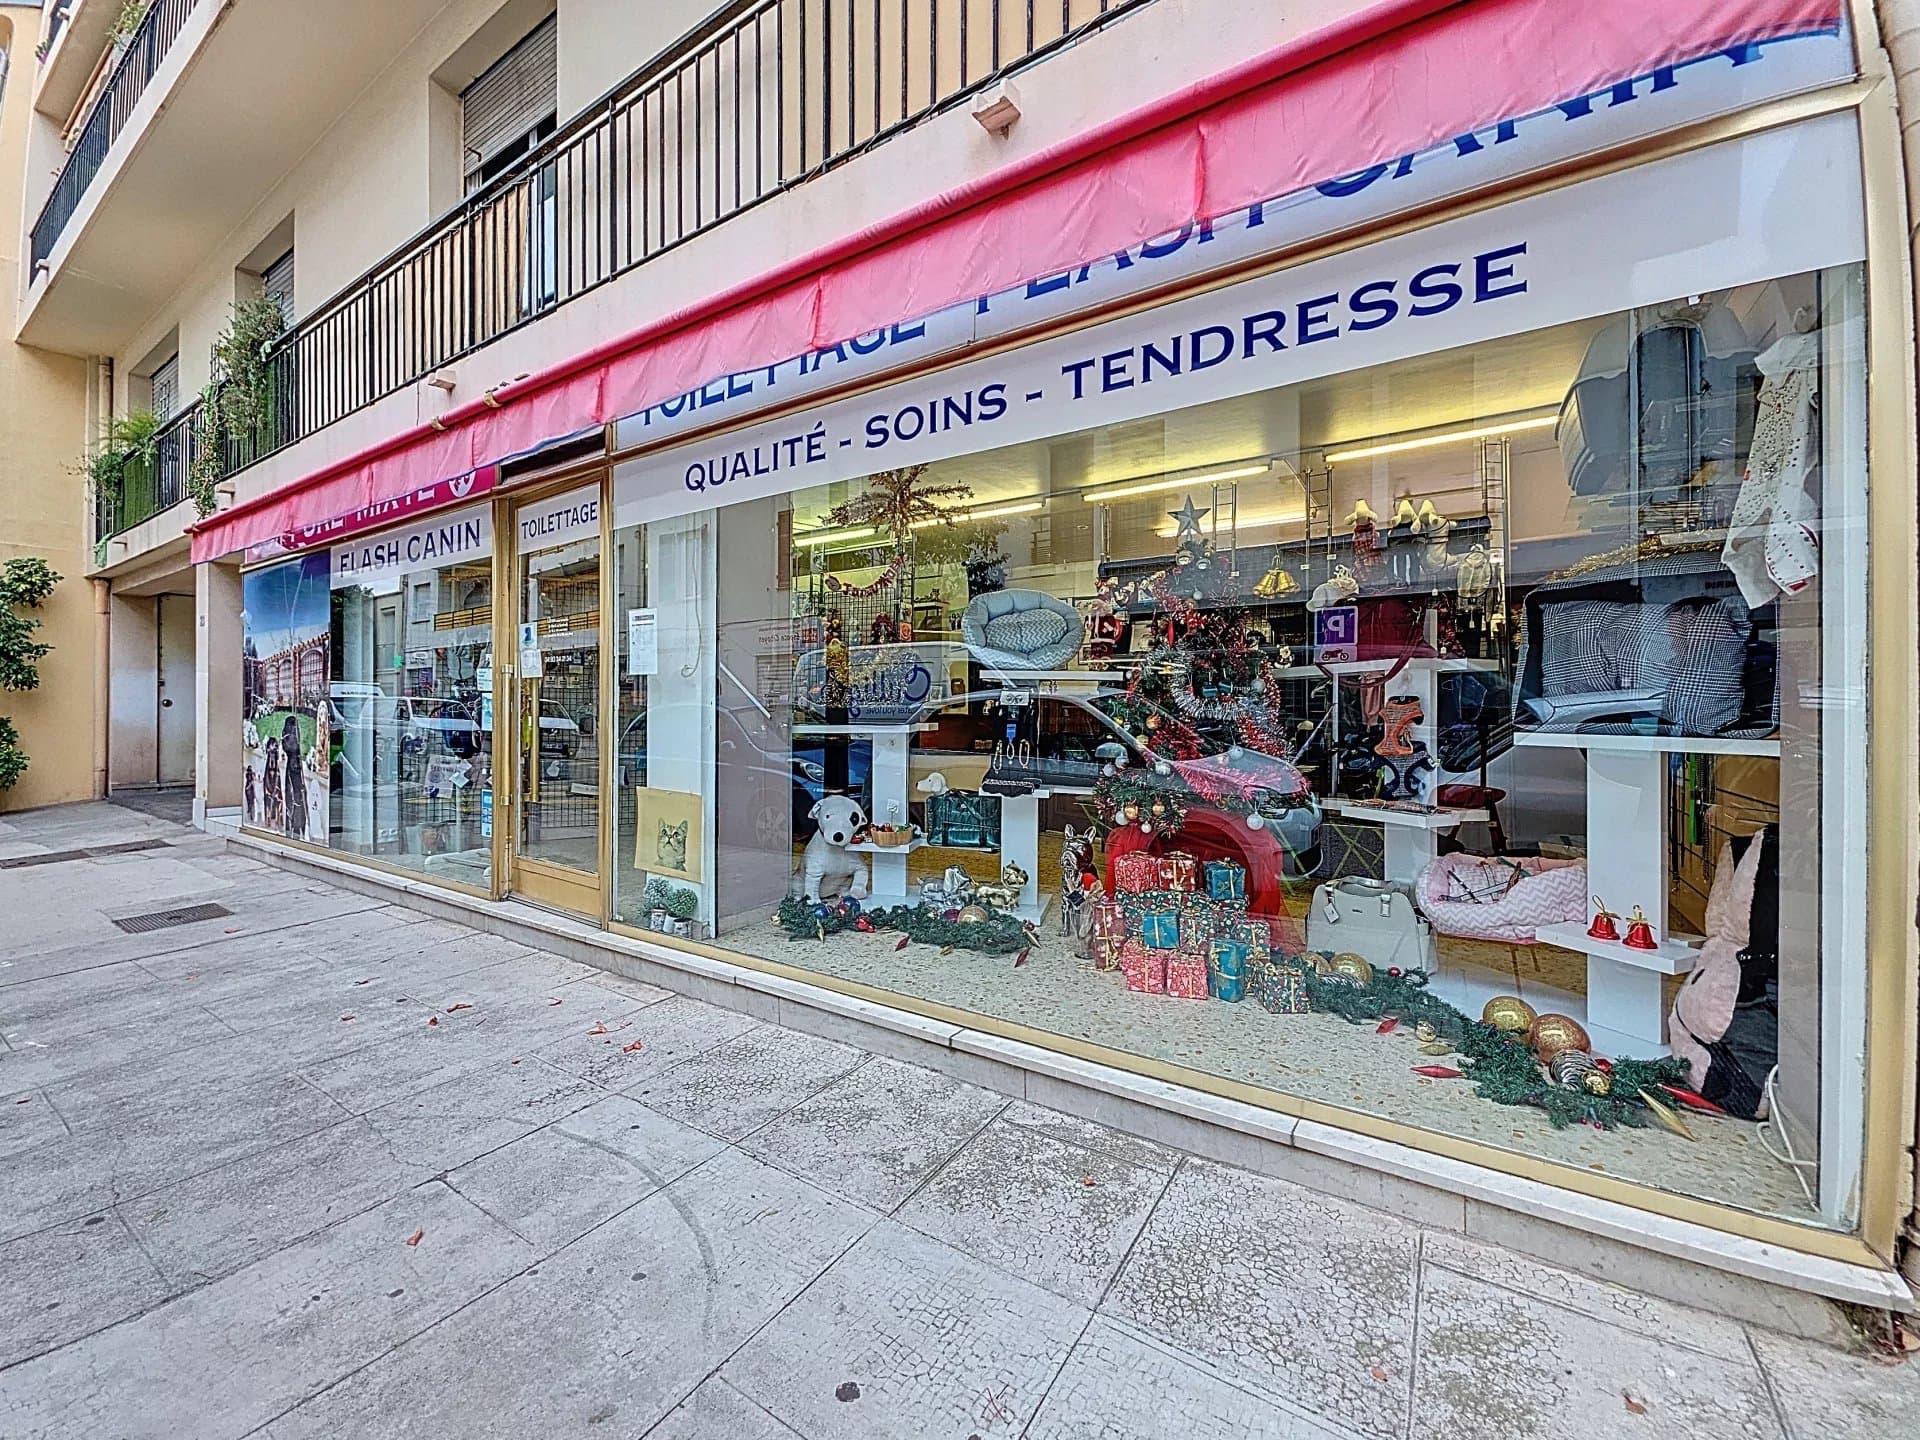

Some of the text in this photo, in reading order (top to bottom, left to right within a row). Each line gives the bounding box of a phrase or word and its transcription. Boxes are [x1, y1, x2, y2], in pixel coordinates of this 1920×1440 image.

[685, 420, 826, 493] QUALITÉ
[839, 438, 852, 448] -
[865, 384, 1007, 449] SOINS
[1026, 389, 1042, 402] -
[1062, 241, 1528, 401] TENDRESSE
[340, 518, 481, 578] FLASH CANIN
[521, 501, 598, 539] TOILETTAGE
